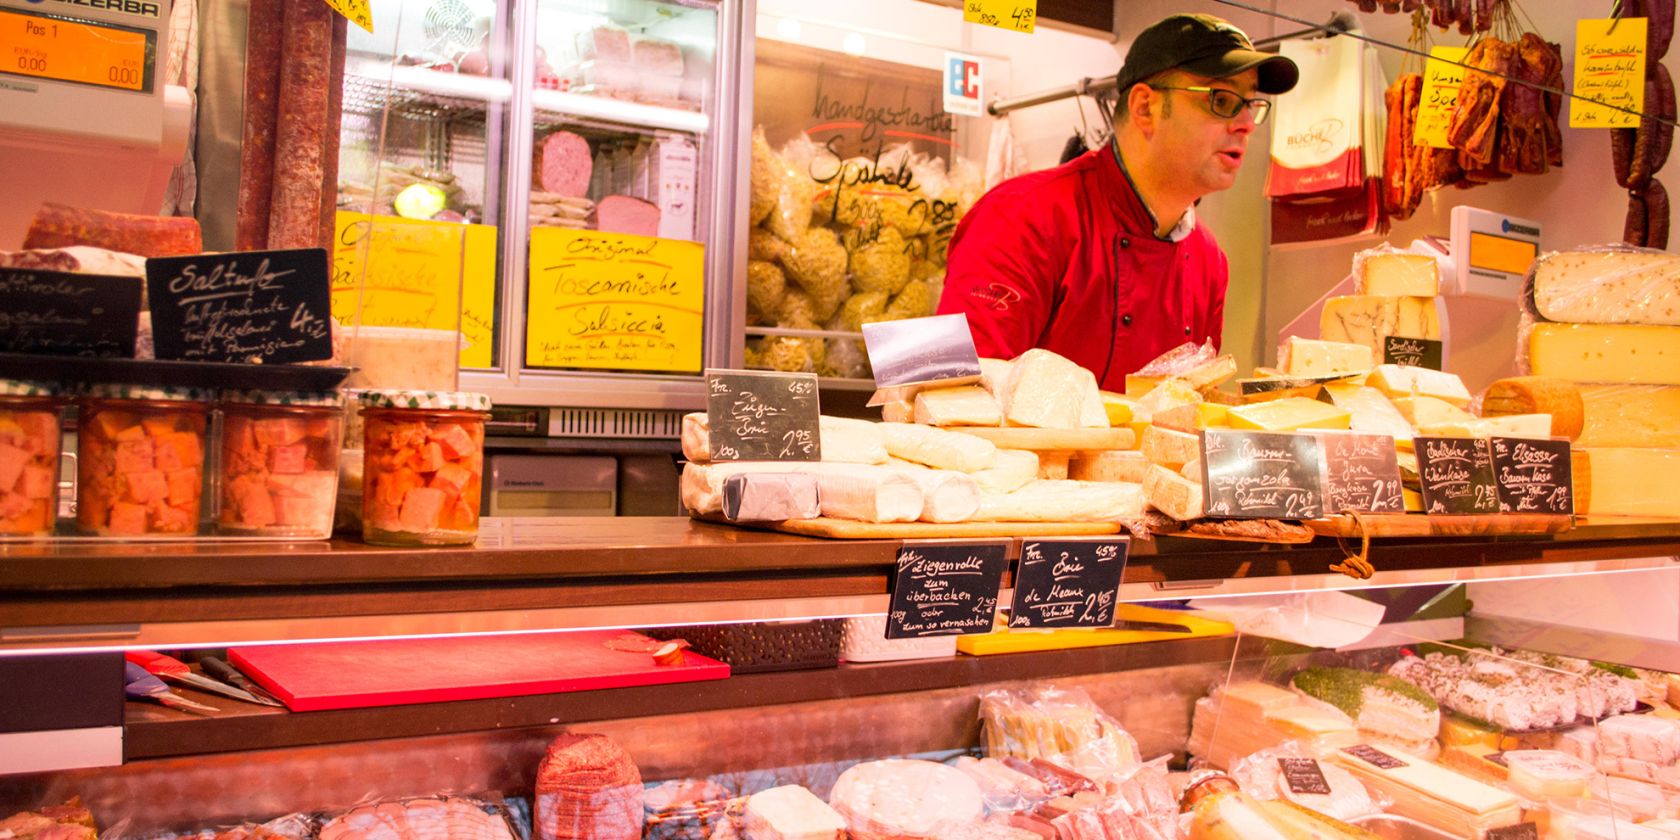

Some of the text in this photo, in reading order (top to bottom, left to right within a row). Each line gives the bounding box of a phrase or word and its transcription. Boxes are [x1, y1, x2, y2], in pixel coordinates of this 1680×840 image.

[26, 20, 57, 38] Pos 1
[18, 56, 47, 72] 0,00
[109, 66, 138, 85] 0,00
[566, 237, 659, 262] Original
[544, 264, 681, 297] Toscanische
[1511, 443, 1559, 464] Elsässer
[1095, 545, 1118, 558] 45%
[912, 556, 984, 576] Ziegenrolle
[1052, 551, 1084, 576] Brie
[906, 587, 972, 601] überbacken
[1024, 584, 1084, 603] de Meaux
[921, 607, 944, 618] oder
[926, 621, 938, 630] so
[940, 614, 990, 629] vernaschen
